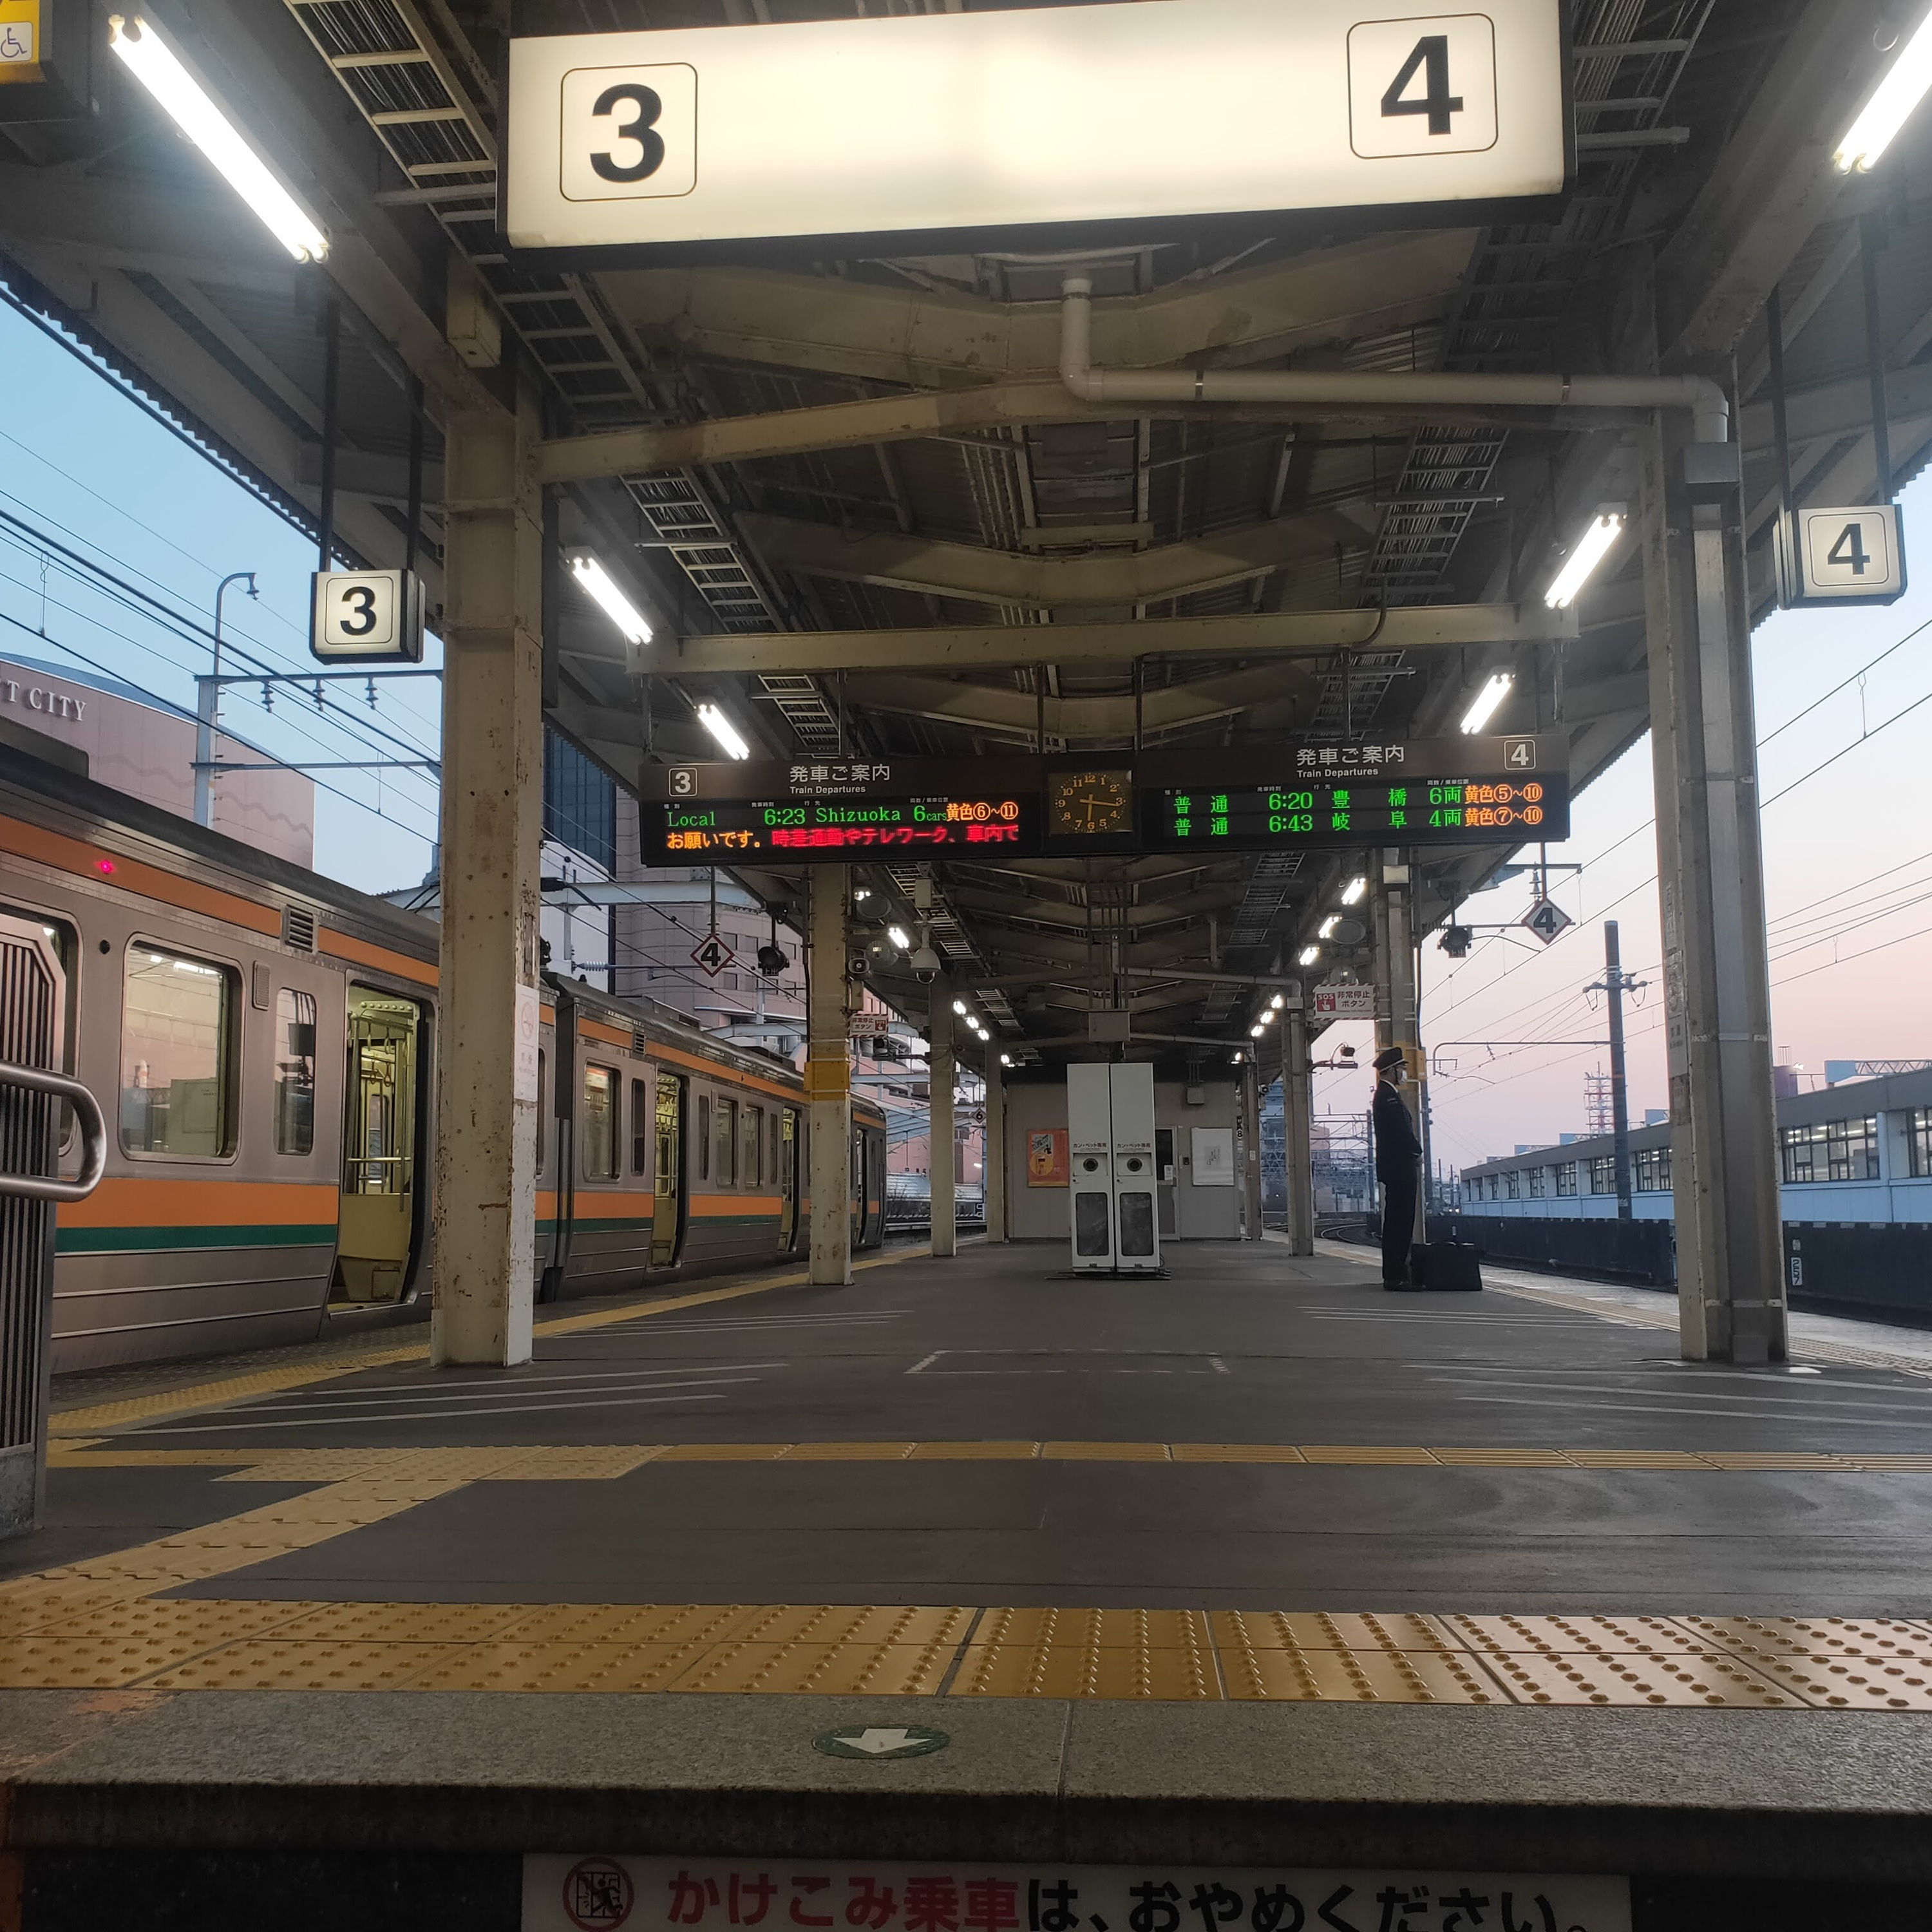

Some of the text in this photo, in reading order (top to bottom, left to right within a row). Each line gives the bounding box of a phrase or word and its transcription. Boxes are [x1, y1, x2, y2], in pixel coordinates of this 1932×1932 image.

[1381, 35, 1463, 133] 4
[591, 84, 663, 182] 3
[1828, 524, 1870, 574] 4
[341, 587, 376, 635] 3
[30, 687, 87, 721] CITY
[1296, 744, 1405, 766] 発車ご案内
[1511, 744, 1529, 766] 4
[674, 772, 692, 793] 3
[790, 764, 891, 782] 発車ご案内
[1073, 779, 1083, 788] 11
[1296, 768, 1379, 778] Train Departures
[790, 784, 866, 795] Train Departures
[1063, 788, 1073, 796] 10
[1269, 792, 1313, 810] 6:20
[1429, 786, 1462, 804] 6両
[1058, 799, 1065, 808] 9
[667, 811, 716, 827] Local
[764, 808, 806, 826] 6:23
[816, 806, 901, 823] Shizuoka
[1099, 819, 1106, 827] 5
[1269, 814, 1313, 833] 6:43
[1428, 808, 1462, 828] 4両
[1533, 907, 1557, 934] 4
[700, 942, 721, 967] 4
[1337, 990, 1370, 999] 非常停止
[976, 1111, 983, 1120] 6
